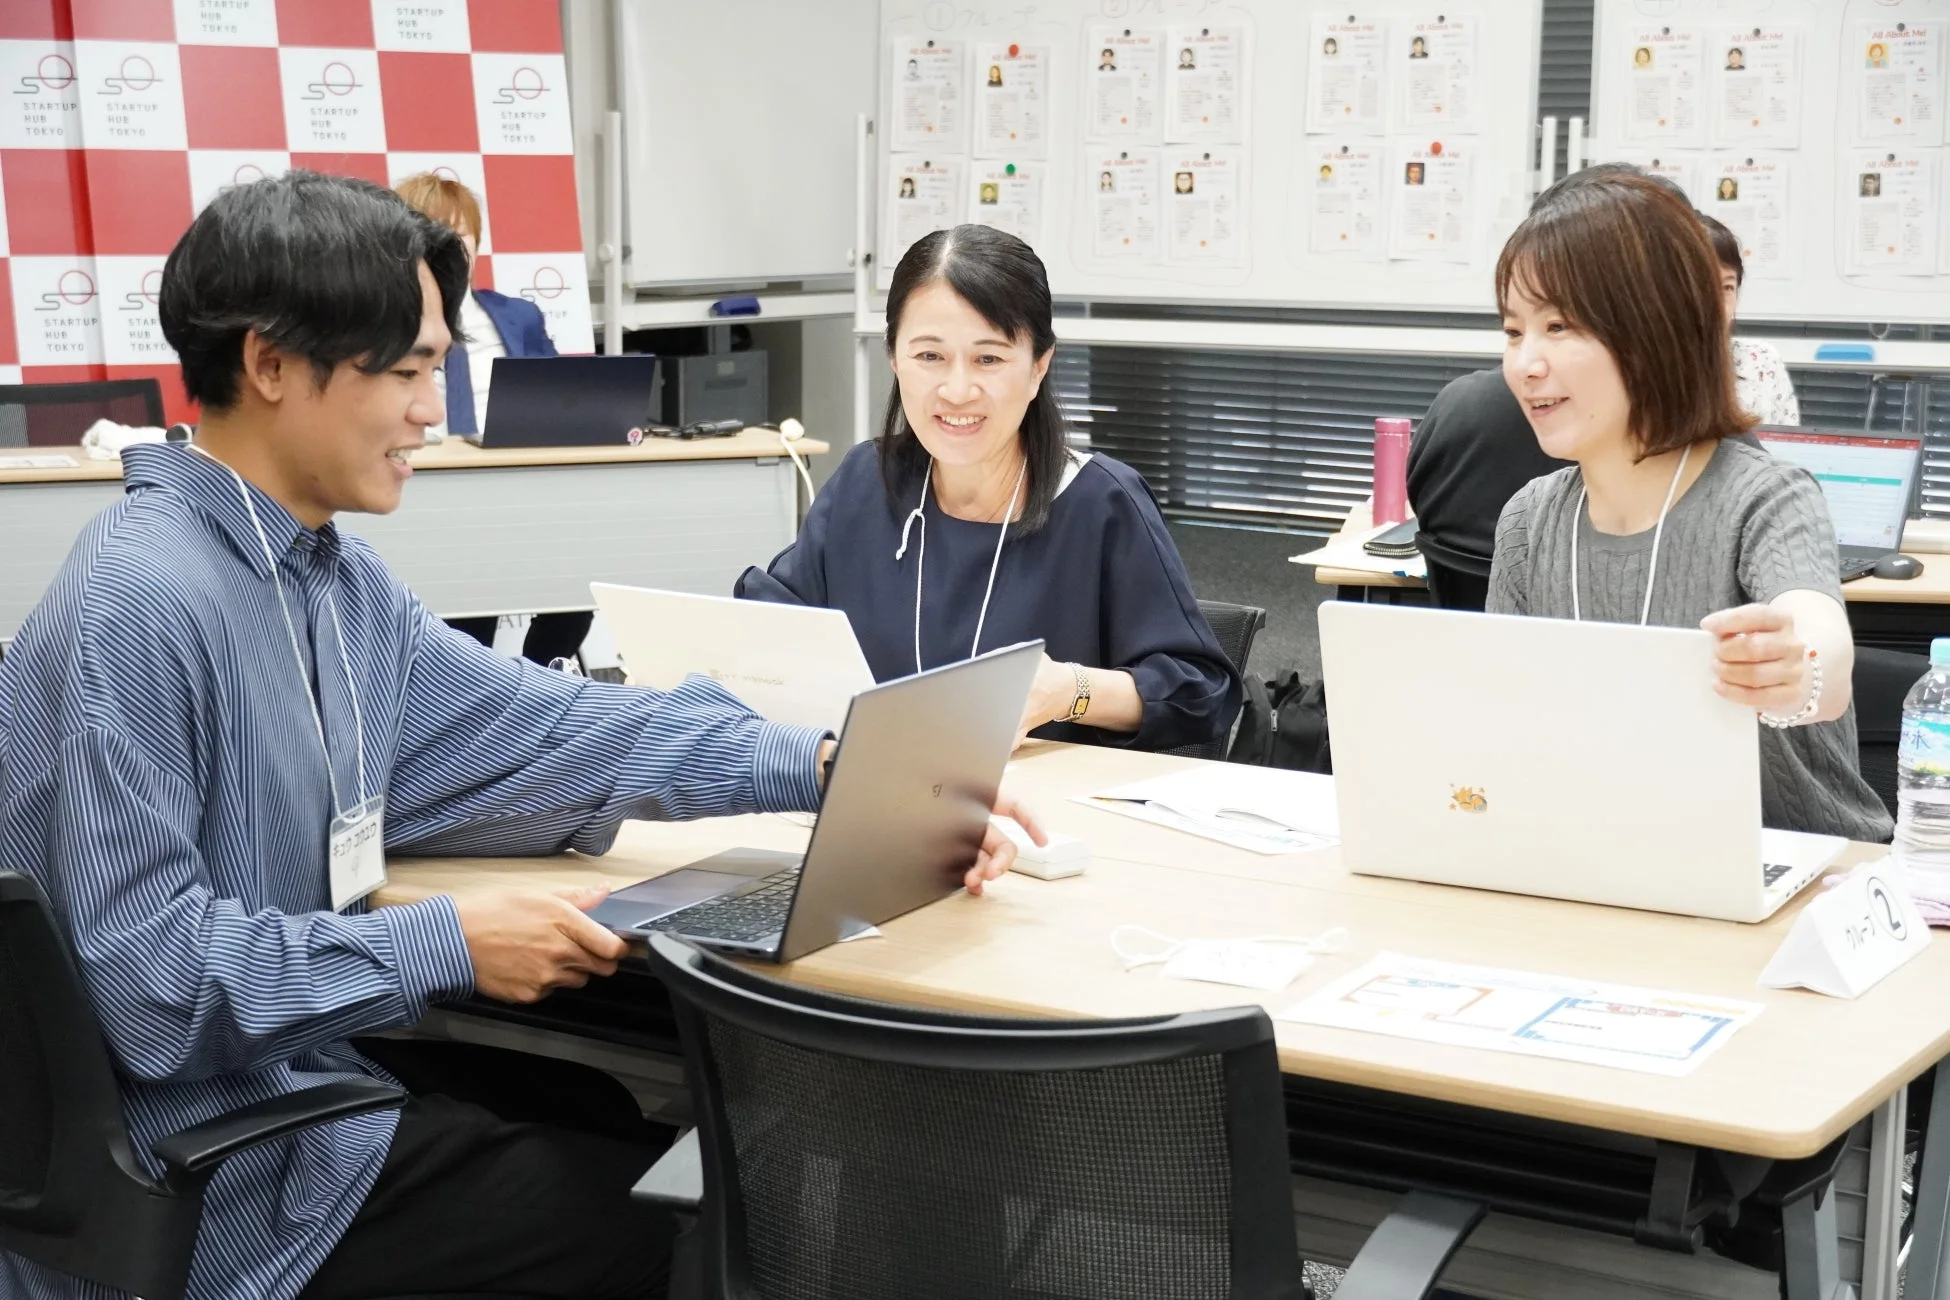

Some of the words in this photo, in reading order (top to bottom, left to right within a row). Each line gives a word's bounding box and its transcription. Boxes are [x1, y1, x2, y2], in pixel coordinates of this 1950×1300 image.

[200, 0, 249, 9] STARTUP
[201, 12, 222, 21] HUB
[396, 8, 444, 17] STARTUP
[397, 19, 418, 28] HUB
[202, 24, 237, 33] TOKYO
[400, 31, 433, 40] TOKYO
[23, 102, 77, 111] STARTUP
[107, 103, 159, 112] STARTUP
[310, 108, 358, 117] STARTUP
[24, 115, 47, 123] HUB
[108, 116, 129, 124] HUB
[311, 119, 331, 128] HUB
[26, 127, 64, 136] TOKYO
[109, 128, 145, 137] TOKYO
[313, 132, 347, 140] TOKYO
[44, 318, 98, 327] STARTUP
[128, 318, 160, 327] STAR
[45, 330, 68, 339] HUB
[129, 331, 151, 339] HUB
[47, 343, 85, 352] TOKYO
[130, 343, 167, 352] TOKYO
